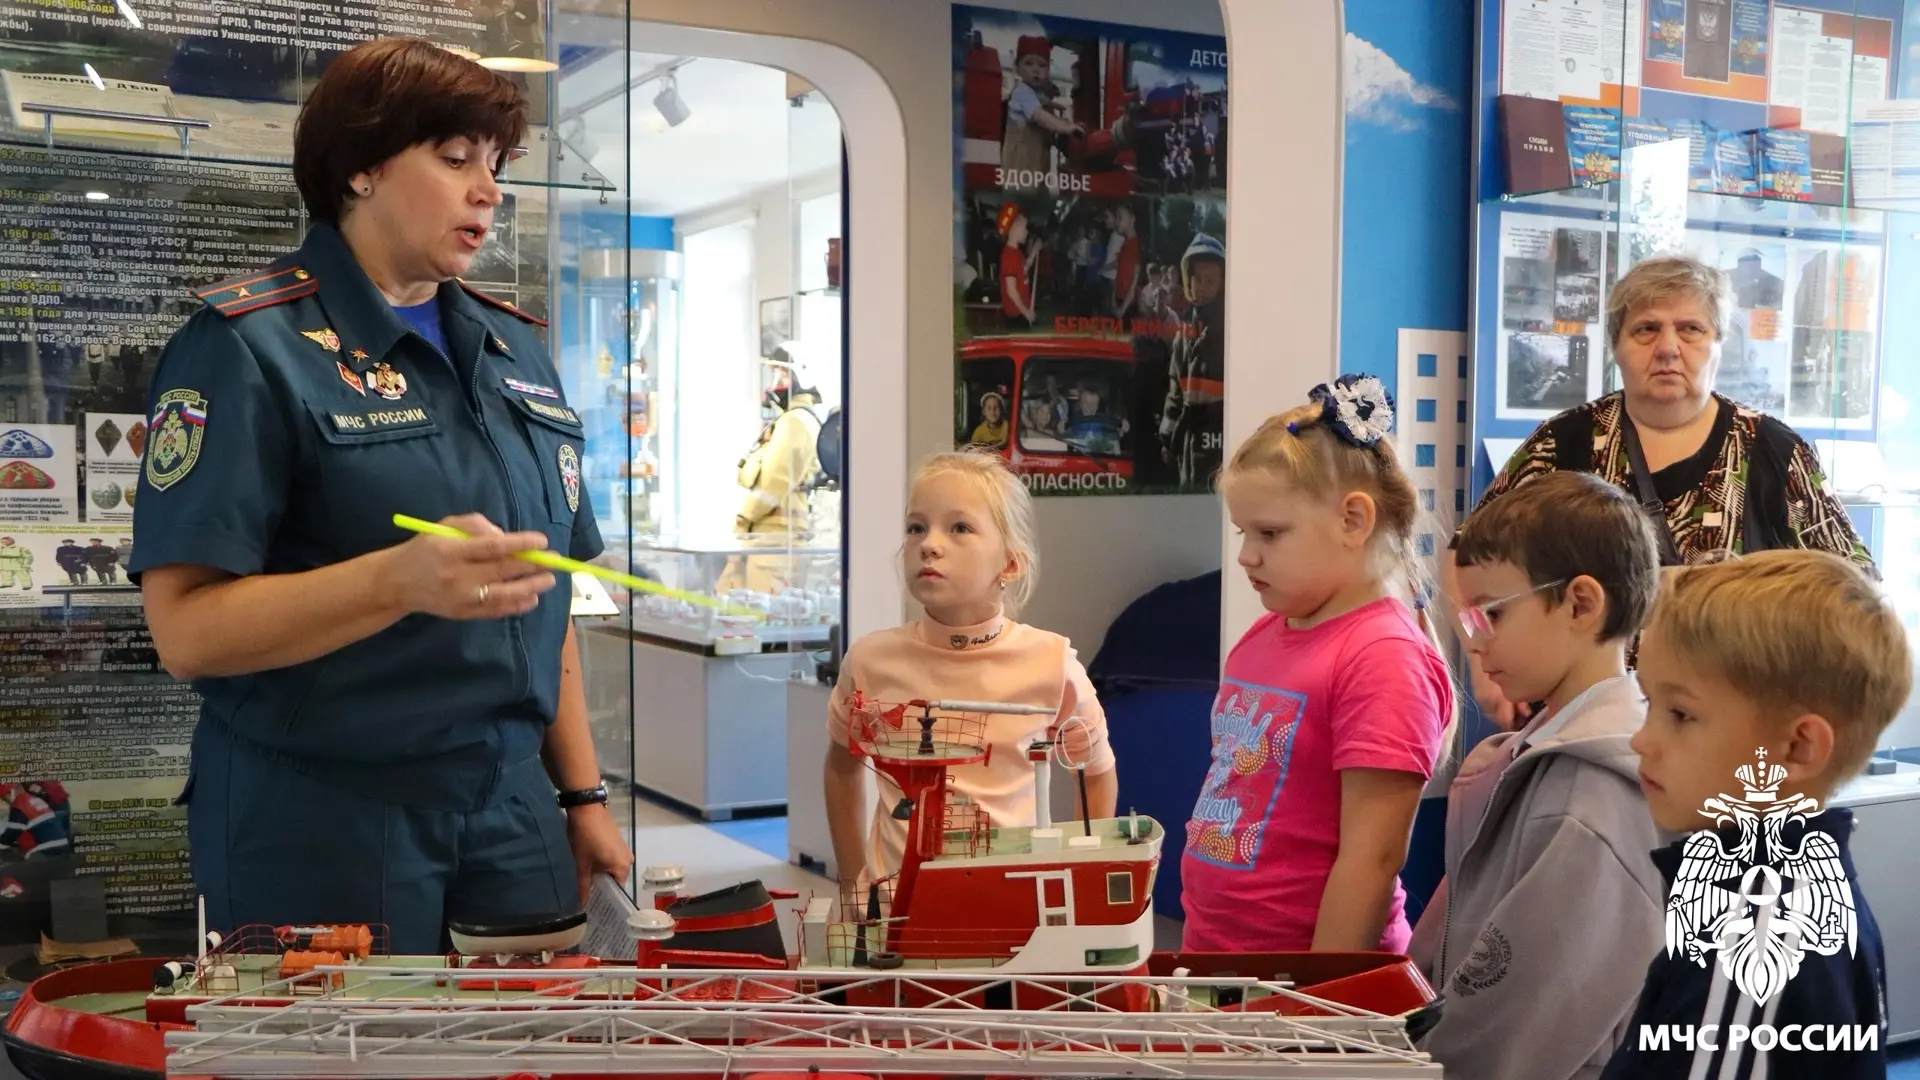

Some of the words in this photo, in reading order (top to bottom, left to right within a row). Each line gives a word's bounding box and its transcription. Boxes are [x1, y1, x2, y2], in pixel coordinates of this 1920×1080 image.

[90, 4, 115, 14] года
[175, 13, 219, 25] усилиям
[221, 16, 252, 29] ИРПО,
[254, 20, 325, 36] Петербургская
[175, 1, 212, 12] членам
[215, 5, 245, 15] семей
[248, 7, 297, 19] пожарных
[308, 15, 342, 27] случае
[344, 19, 376, 30] потери
[378, 22, 430, 36] кормильца.
[343, 7, 378, 17] прочего
[382, 10, 414, 21] ущерба
[40, 12, 89, 23] техников
[148, 23, 219, 38] современного
[221, 29, 287, 46] Университета
[1523, 143, 1554, 153] ПРАВИЛ
[111, 158, 174, 171] Комиссаром
[234, 169, 251, 179] дел
[68, 168, 122, 182] пожарных
[125, 173, 165, 185] дружин
[176, 177, 248, 192] добровольных
[994, 168, 1091, 192] ЗДОРОВЬЕ
[54, 193, 85, 203] Совет
[148, 198, 174, 209] СССР
[177, 201, 212, 213] принял
[216, 203, 287, 217] постановление
[28, 205, 104, 219] добровольных
[107, 209, 161, 223] пожарных
[163, 213, 202, 226] дружин
[218, 217, 294, 230] промышленных
[21, 218, 57, 231] других
[60, 219, 114, 232] объектах
[117, 223, 176, 235] министерств
[60, 233, 89, 243] Совет
[92, 235, 148, 247] Министров
[193, 240, 247, 253] принимает
[117, 248, 152, 259] ноябре
[156, 251, 182, 261] этого
[202, 254, 225, 264] года
[20, 256, 90, 269] конференция
[93, 259, 175, 274] Всероссийского
[40, 272, 84, 284] приняла
[87, 273, 115, 283] Устав
[118, 274, 171, 287] Общества.
[76, 284, 137, 296] Ленинграде
[31, 295, 64, 305] ВДПО.
[10, 307, 34, 317] 1984
[37, 308, 62, 319] года
[64, 311, 83, 320] для
[85, 311, 143, 323] улучшения
[28, 321, 73, 333] тушения
[127, 325, 154, 335] Совет
[37, 334, 56, 343] 162
[75, 336, 109, 347] работе
[334, 414, 366, 429] МЧС
[367, 408, 428, 426] РОССИИ
[68, 683, 92, 694] ВДПО
[73, 738, 98, 748] ВДПО
